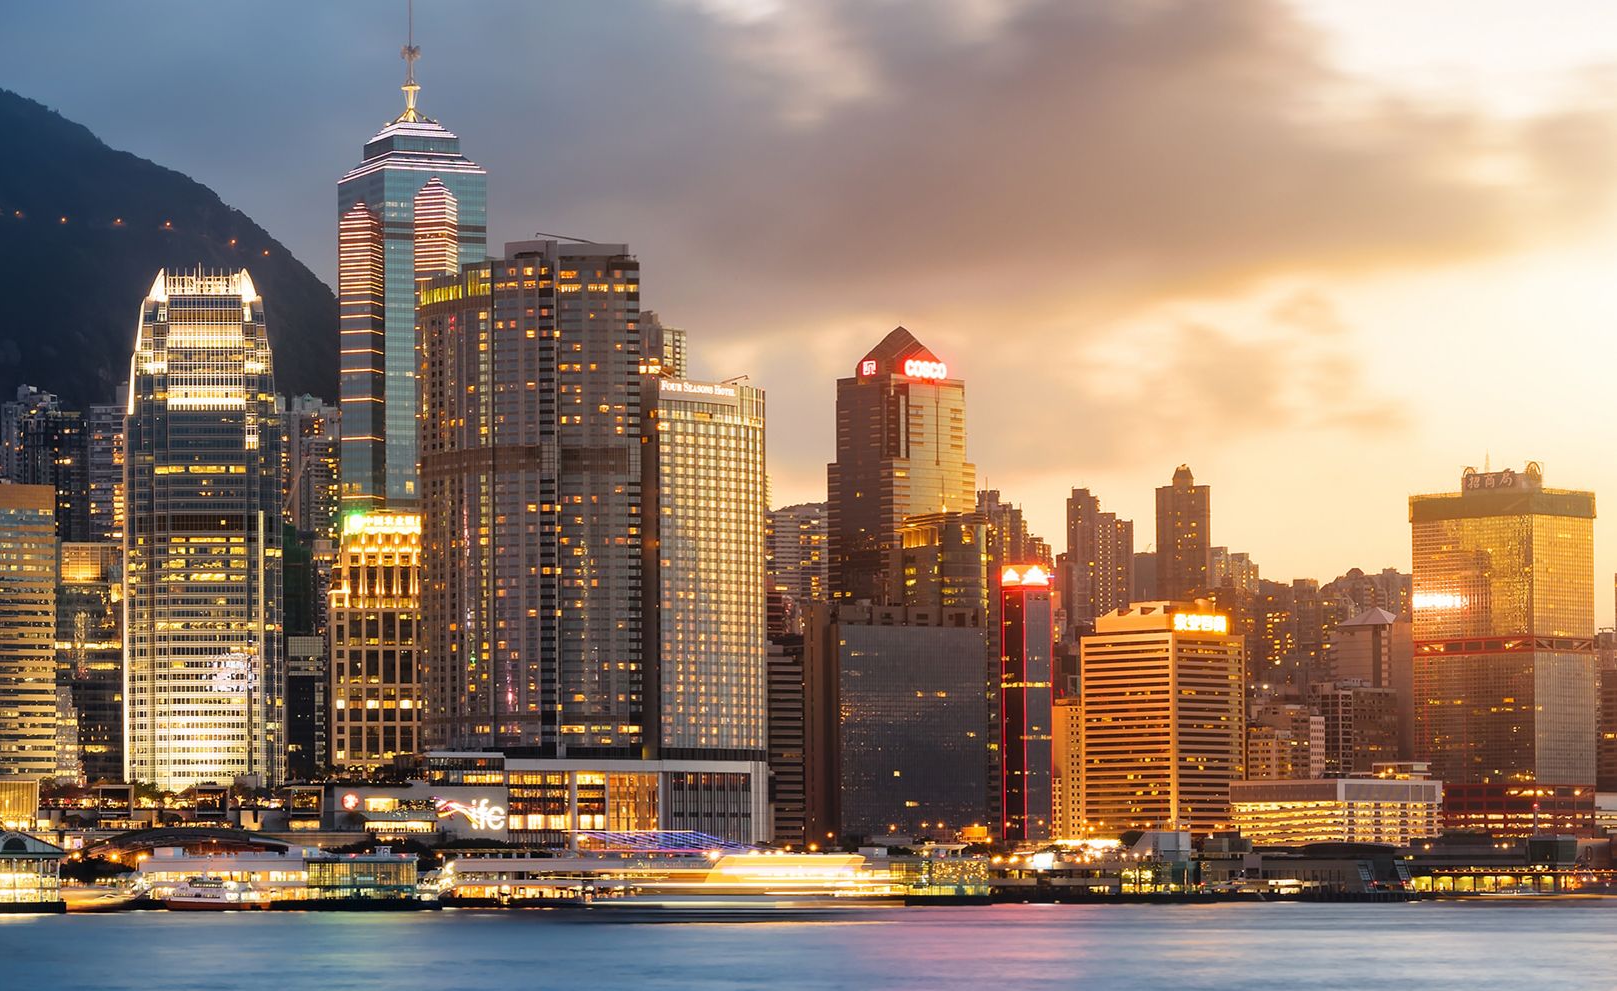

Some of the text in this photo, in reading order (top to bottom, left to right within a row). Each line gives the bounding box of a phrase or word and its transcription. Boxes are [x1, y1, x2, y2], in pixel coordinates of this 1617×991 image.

[904, 359, 947, 380] COSCO
[661, 380, 736, 397] FOUR SEASONS HOTEL
[1467, 468, 1515, 489] 招商局
[471, 798, 505, 830] ifc
